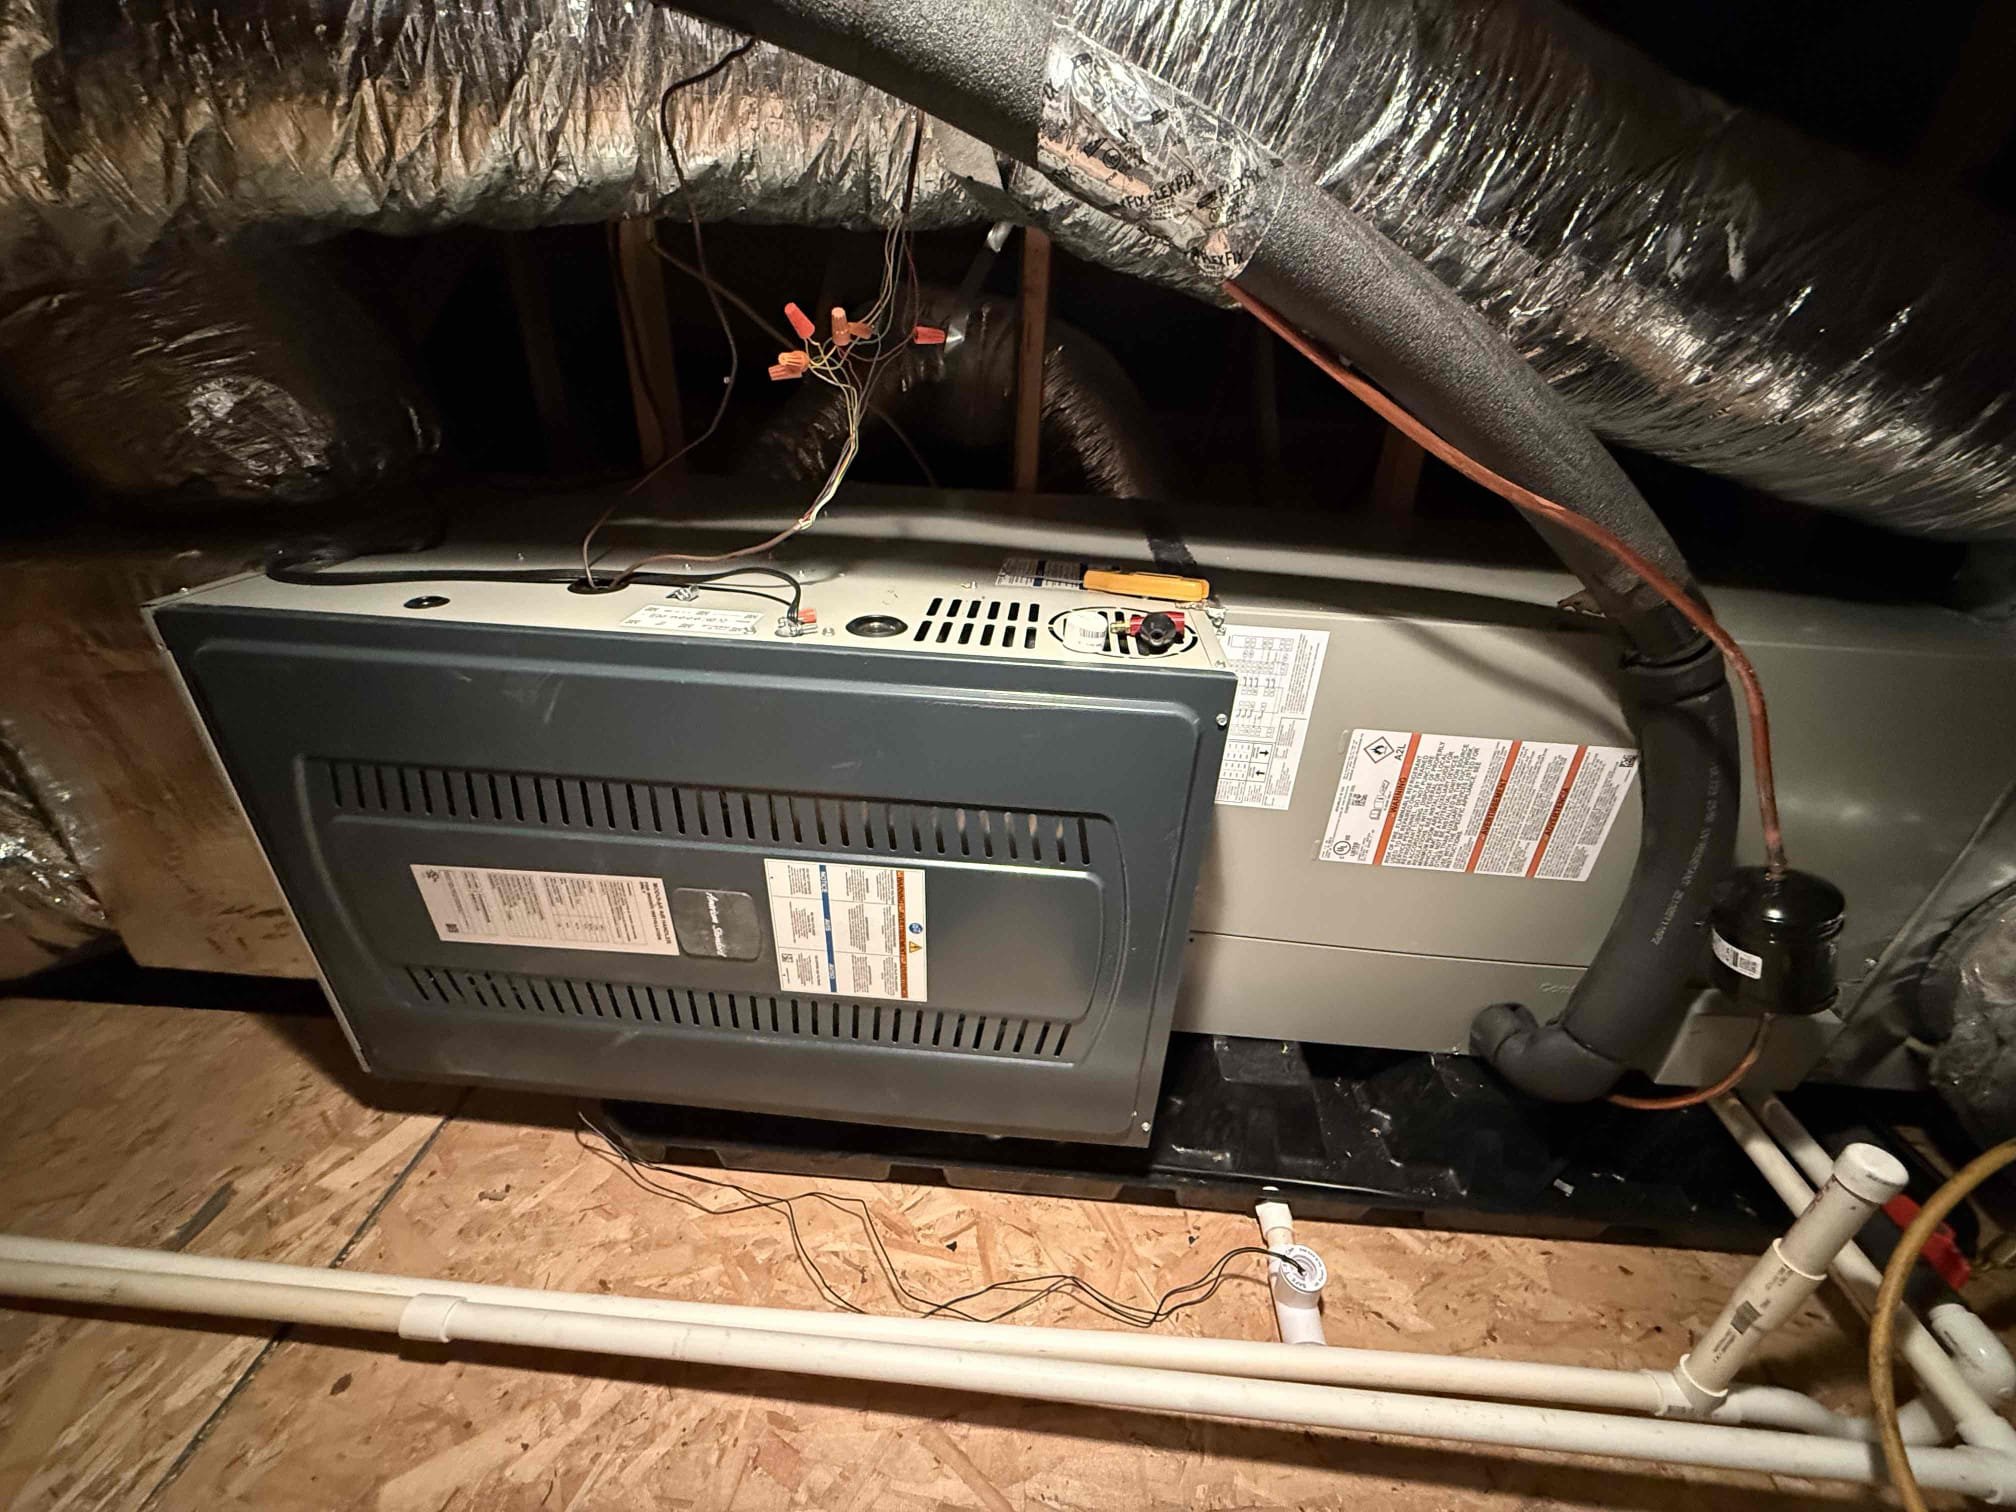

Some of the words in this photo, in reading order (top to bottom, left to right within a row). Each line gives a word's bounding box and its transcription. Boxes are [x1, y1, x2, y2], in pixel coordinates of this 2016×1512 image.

[1393, 743, 1406, 760] A2L
[1389, 777, 1406, 812] WARNING
[1480, 779, 1507, 834] AVERTISSEMENT
[1543, 787, 1569, 836] ADVERTENCIA
